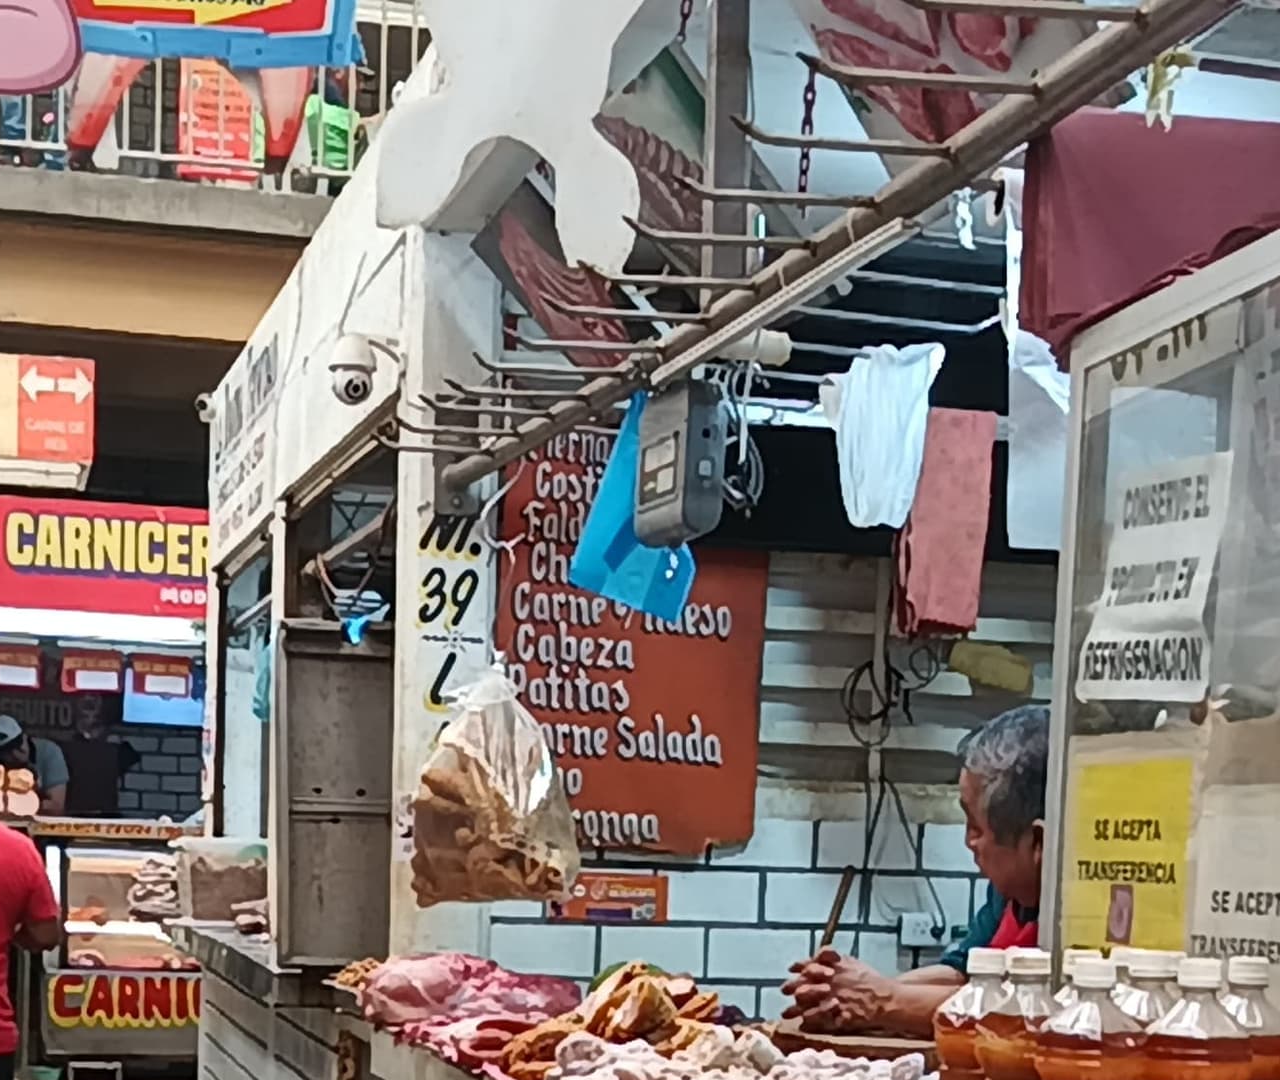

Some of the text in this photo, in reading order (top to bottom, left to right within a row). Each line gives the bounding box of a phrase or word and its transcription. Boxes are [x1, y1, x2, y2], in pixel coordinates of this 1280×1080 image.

[525, 431, 609, 464] ierna
[418, 566, 480, 628] 39
[514, 582, 609, 629] Carne
[516, 621, 635, 671] Cabeza
[541, 715, 724, 765] arne Salada
[1093, 818, 1162, 841] SE ACEPTA
[1210, 890, 1231, 914] SE
